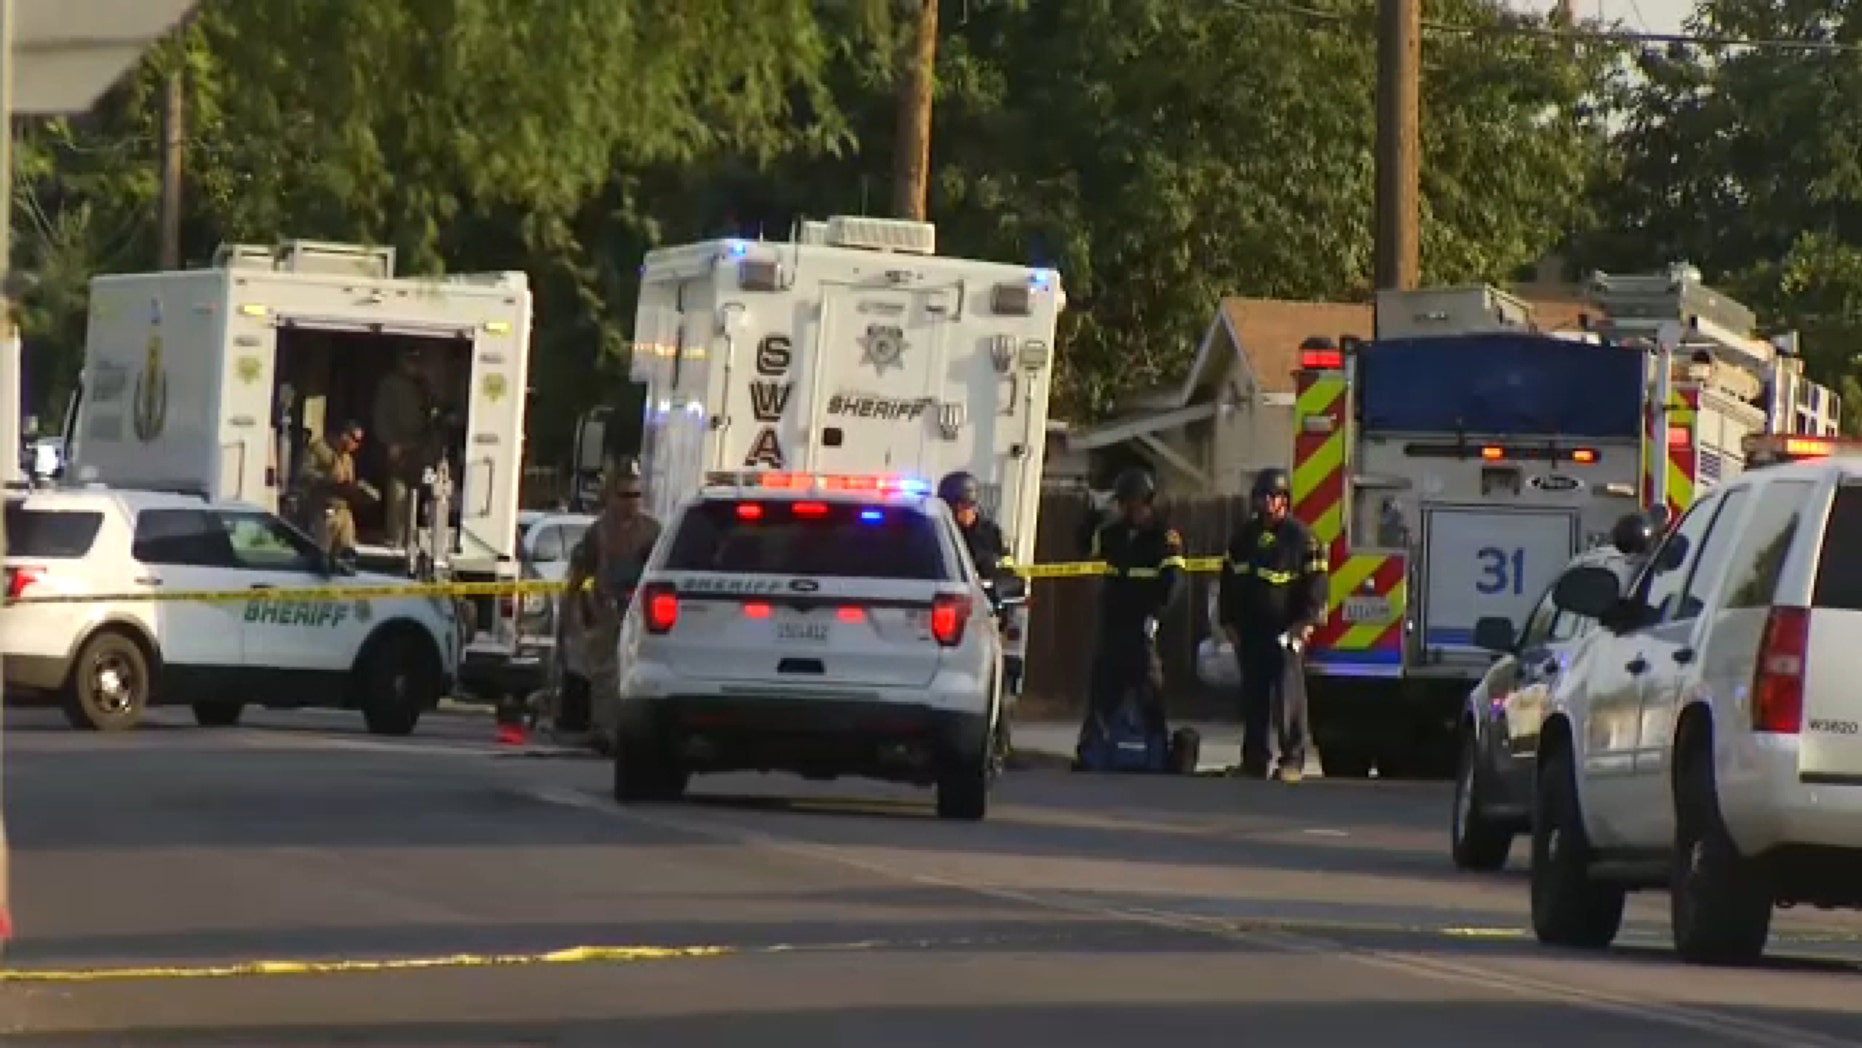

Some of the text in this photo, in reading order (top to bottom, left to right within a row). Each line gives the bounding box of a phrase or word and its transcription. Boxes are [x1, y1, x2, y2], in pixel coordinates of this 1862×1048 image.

[744, 335, 792, 468] SWA
[827, 395, 932, 421] SHERIFF
[1475, 546, 1526, 595] 31
[244, 601, 350, 628] SHERIFF
